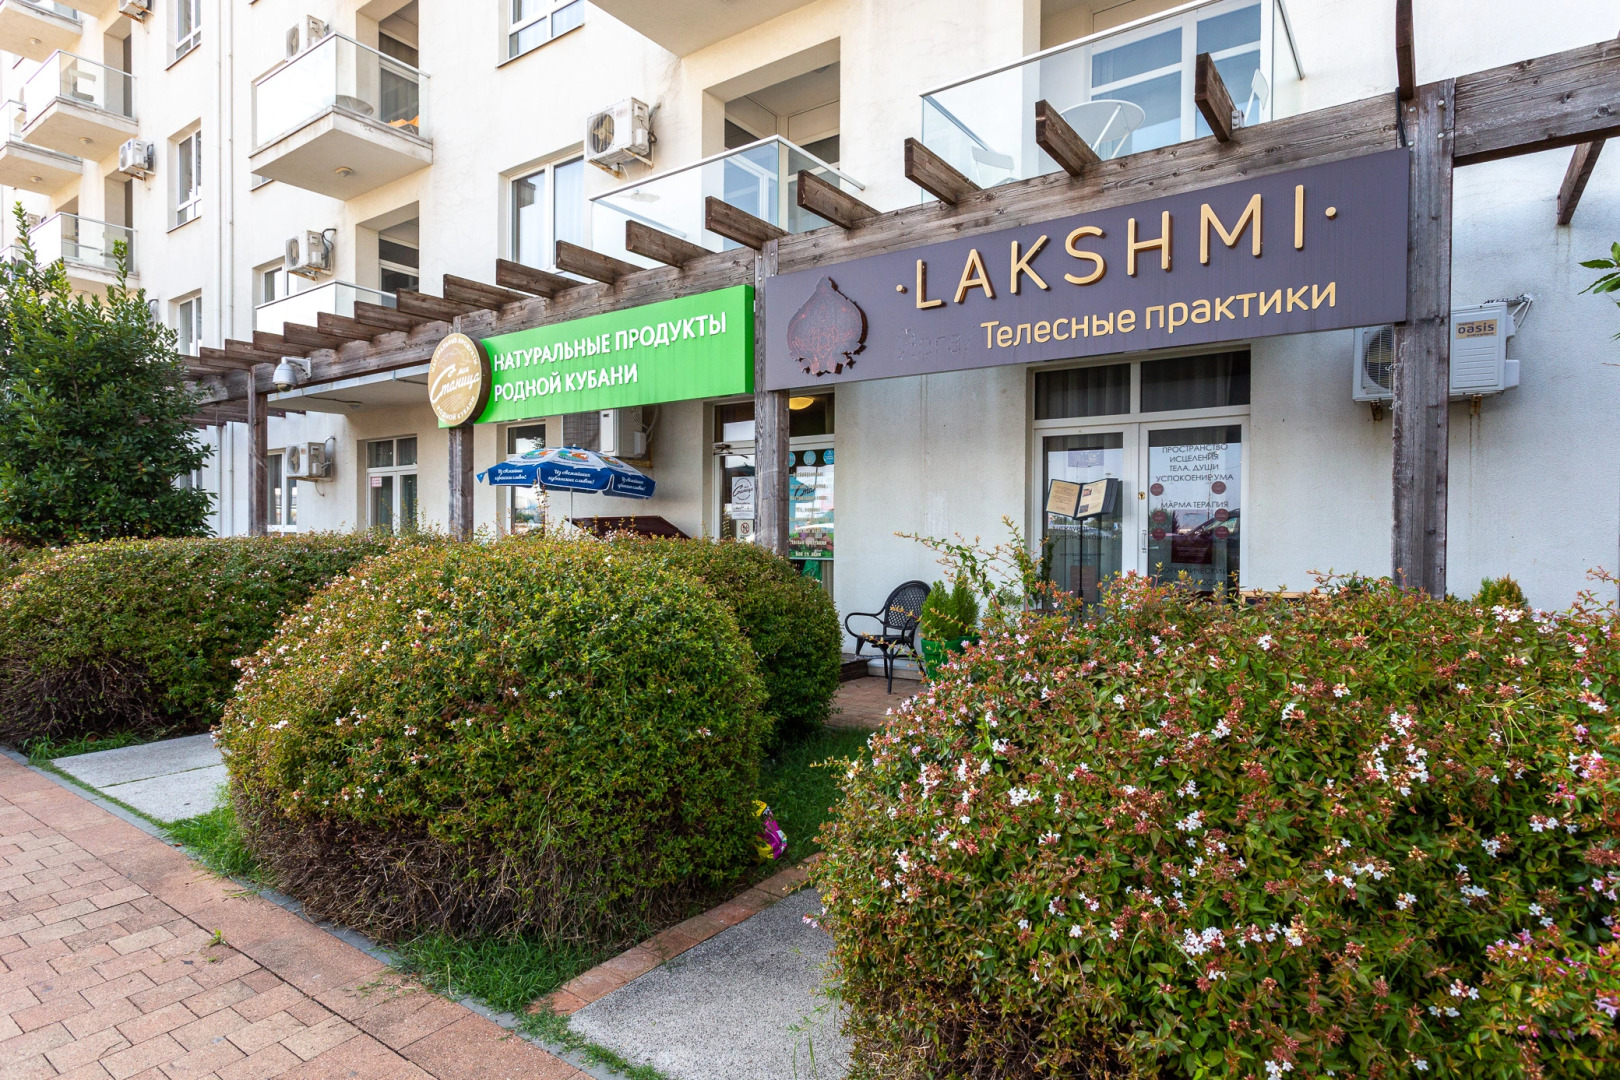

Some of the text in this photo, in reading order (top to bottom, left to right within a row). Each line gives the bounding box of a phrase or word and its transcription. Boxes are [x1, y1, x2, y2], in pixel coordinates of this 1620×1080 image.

[981, 309, 1136, 348] Телесные
[1145, 282, 1337, 333] практики
[1458, 322, 1494, 334] oasis
[494, 312, 726, 372] НАТУРАЛЬНЫЕ ПРОДУКТЫ
[430, 363, 481, 404] Станица
[494, 363, 638, 402] РОДНОЙ КУБАНИ
[436, 396, 476, 421] РОДНОЙ КУБАНИ
[1162, 444, 1228, 453] ПРОСТРАНСТВО
[1169, 454, 1219, 463] ИСЦЕЛЕНИЯ
[1156, 474, 1212, 482] УСПОКОЕНИЕ
[1193, 500, 1229, 508] ТЕРАПИЯ
